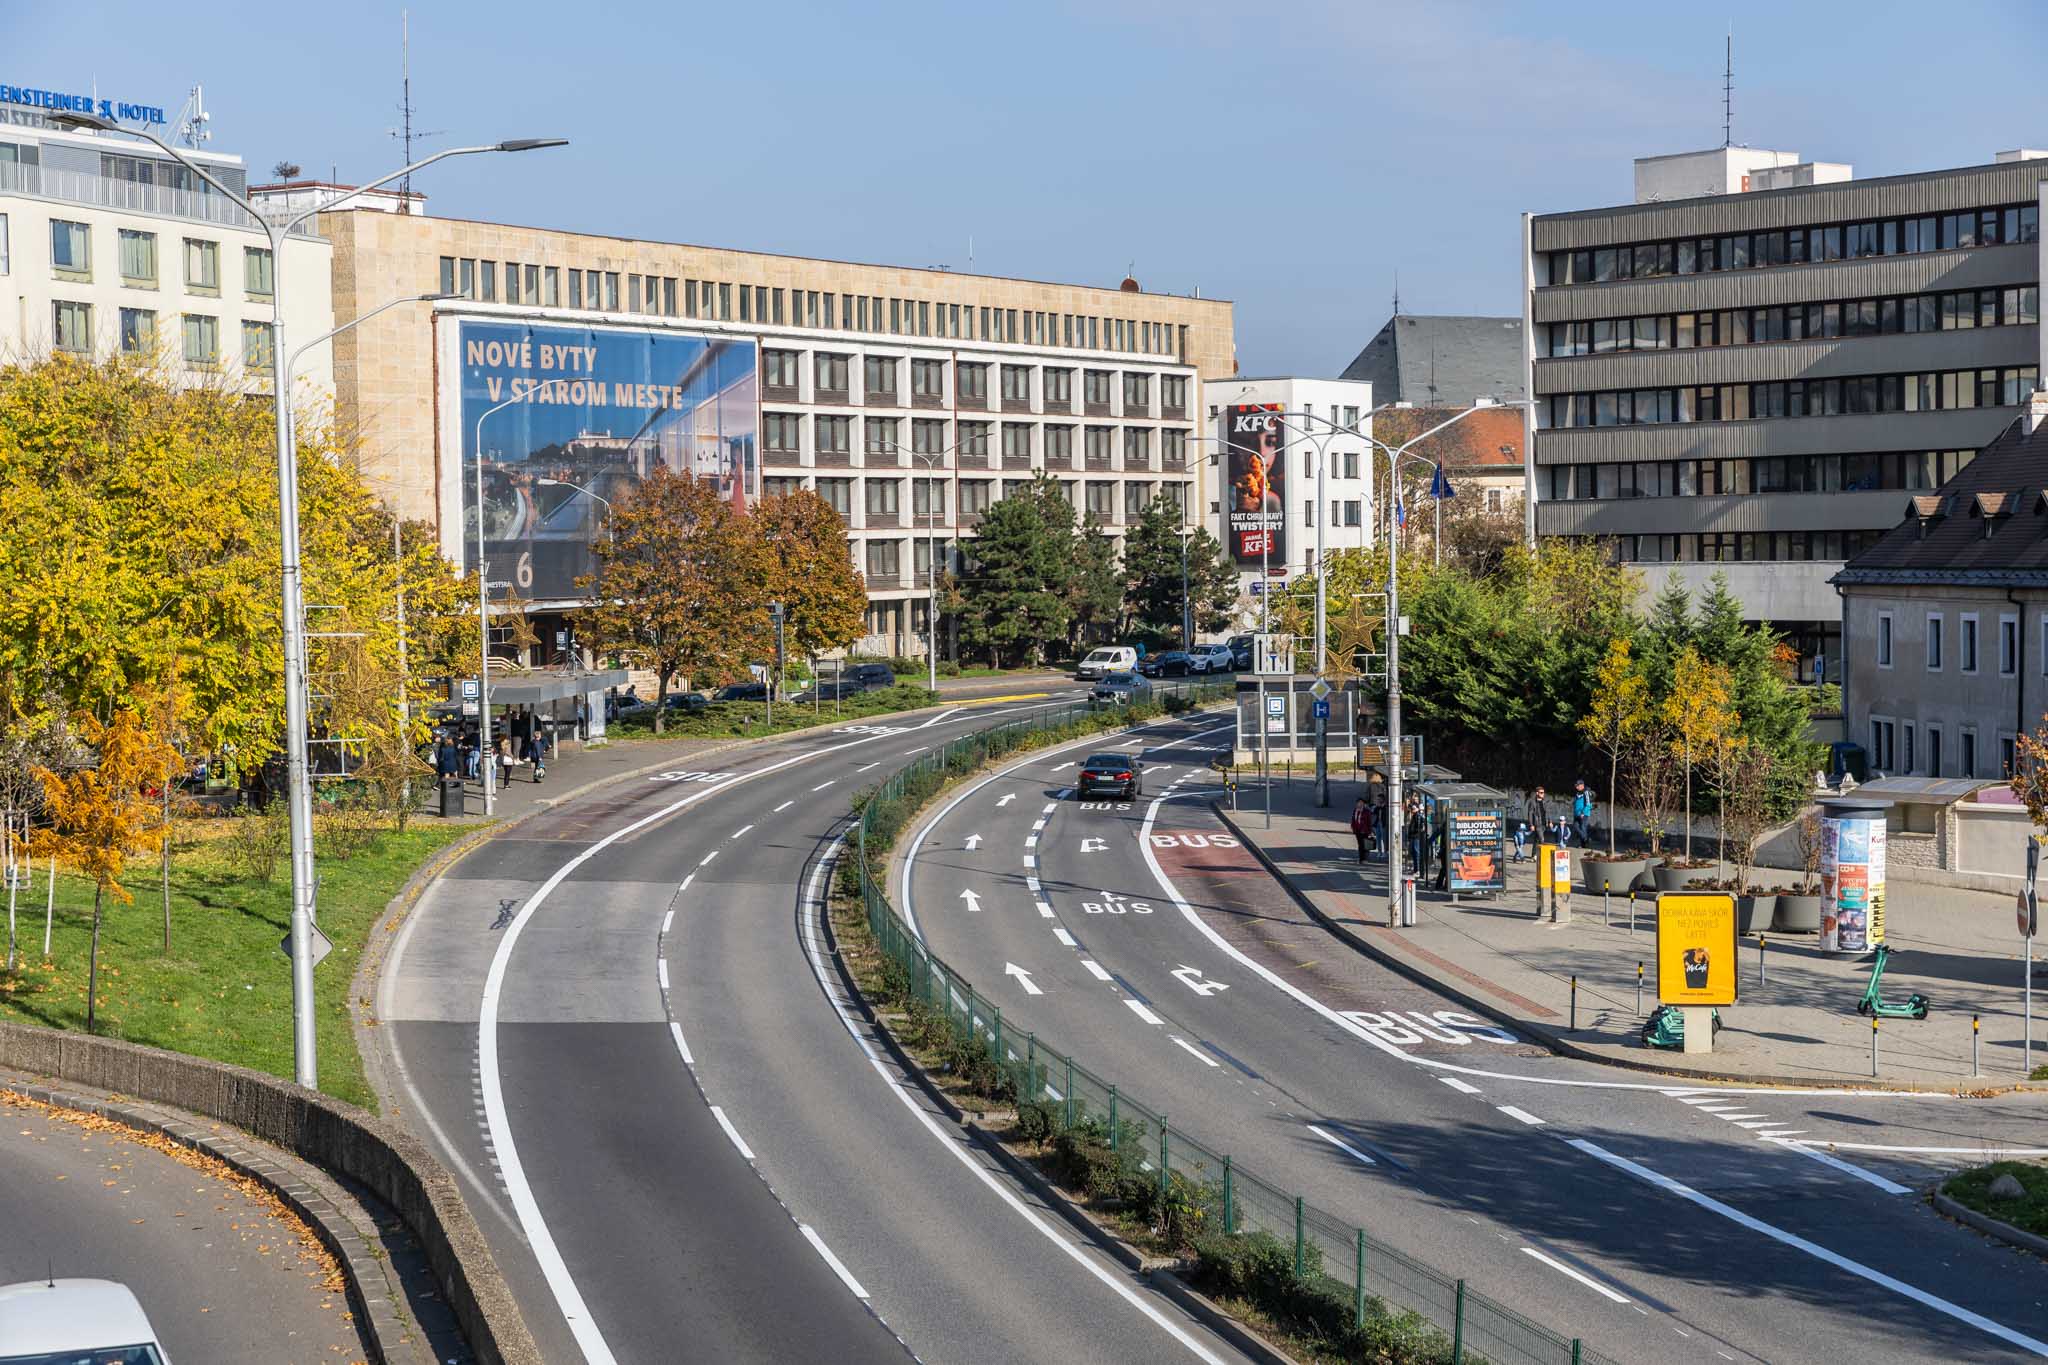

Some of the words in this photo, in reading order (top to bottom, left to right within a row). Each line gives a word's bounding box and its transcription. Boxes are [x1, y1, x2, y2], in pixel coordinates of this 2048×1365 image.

[118, 102, 167, 124] HOTEL
[467, 336, 532, 368] NOVÉ
[540, 344, 597, 372] BYTY
[486, 377, 502, 402] V
[511, 377, 606, 406] STAROM
[615, 382, 683, 410] MESTE
[1234, 415, 1277, 432] KFC
[1230, 512, 1246, 521] FAKT
[517, 551, 534, 588] 6
[832, 725, 908, 735] BUS
[649, 771, 736, 783] BUS
[1079, 801, 1132, 810] BUS
[1459, 828, 1494, 836] MODDOM
[1150, 833, 1241, 848] BUS
[1081, 902, 1153, 914] BUS
[1336, 1011, 1519, 1045] BUS
